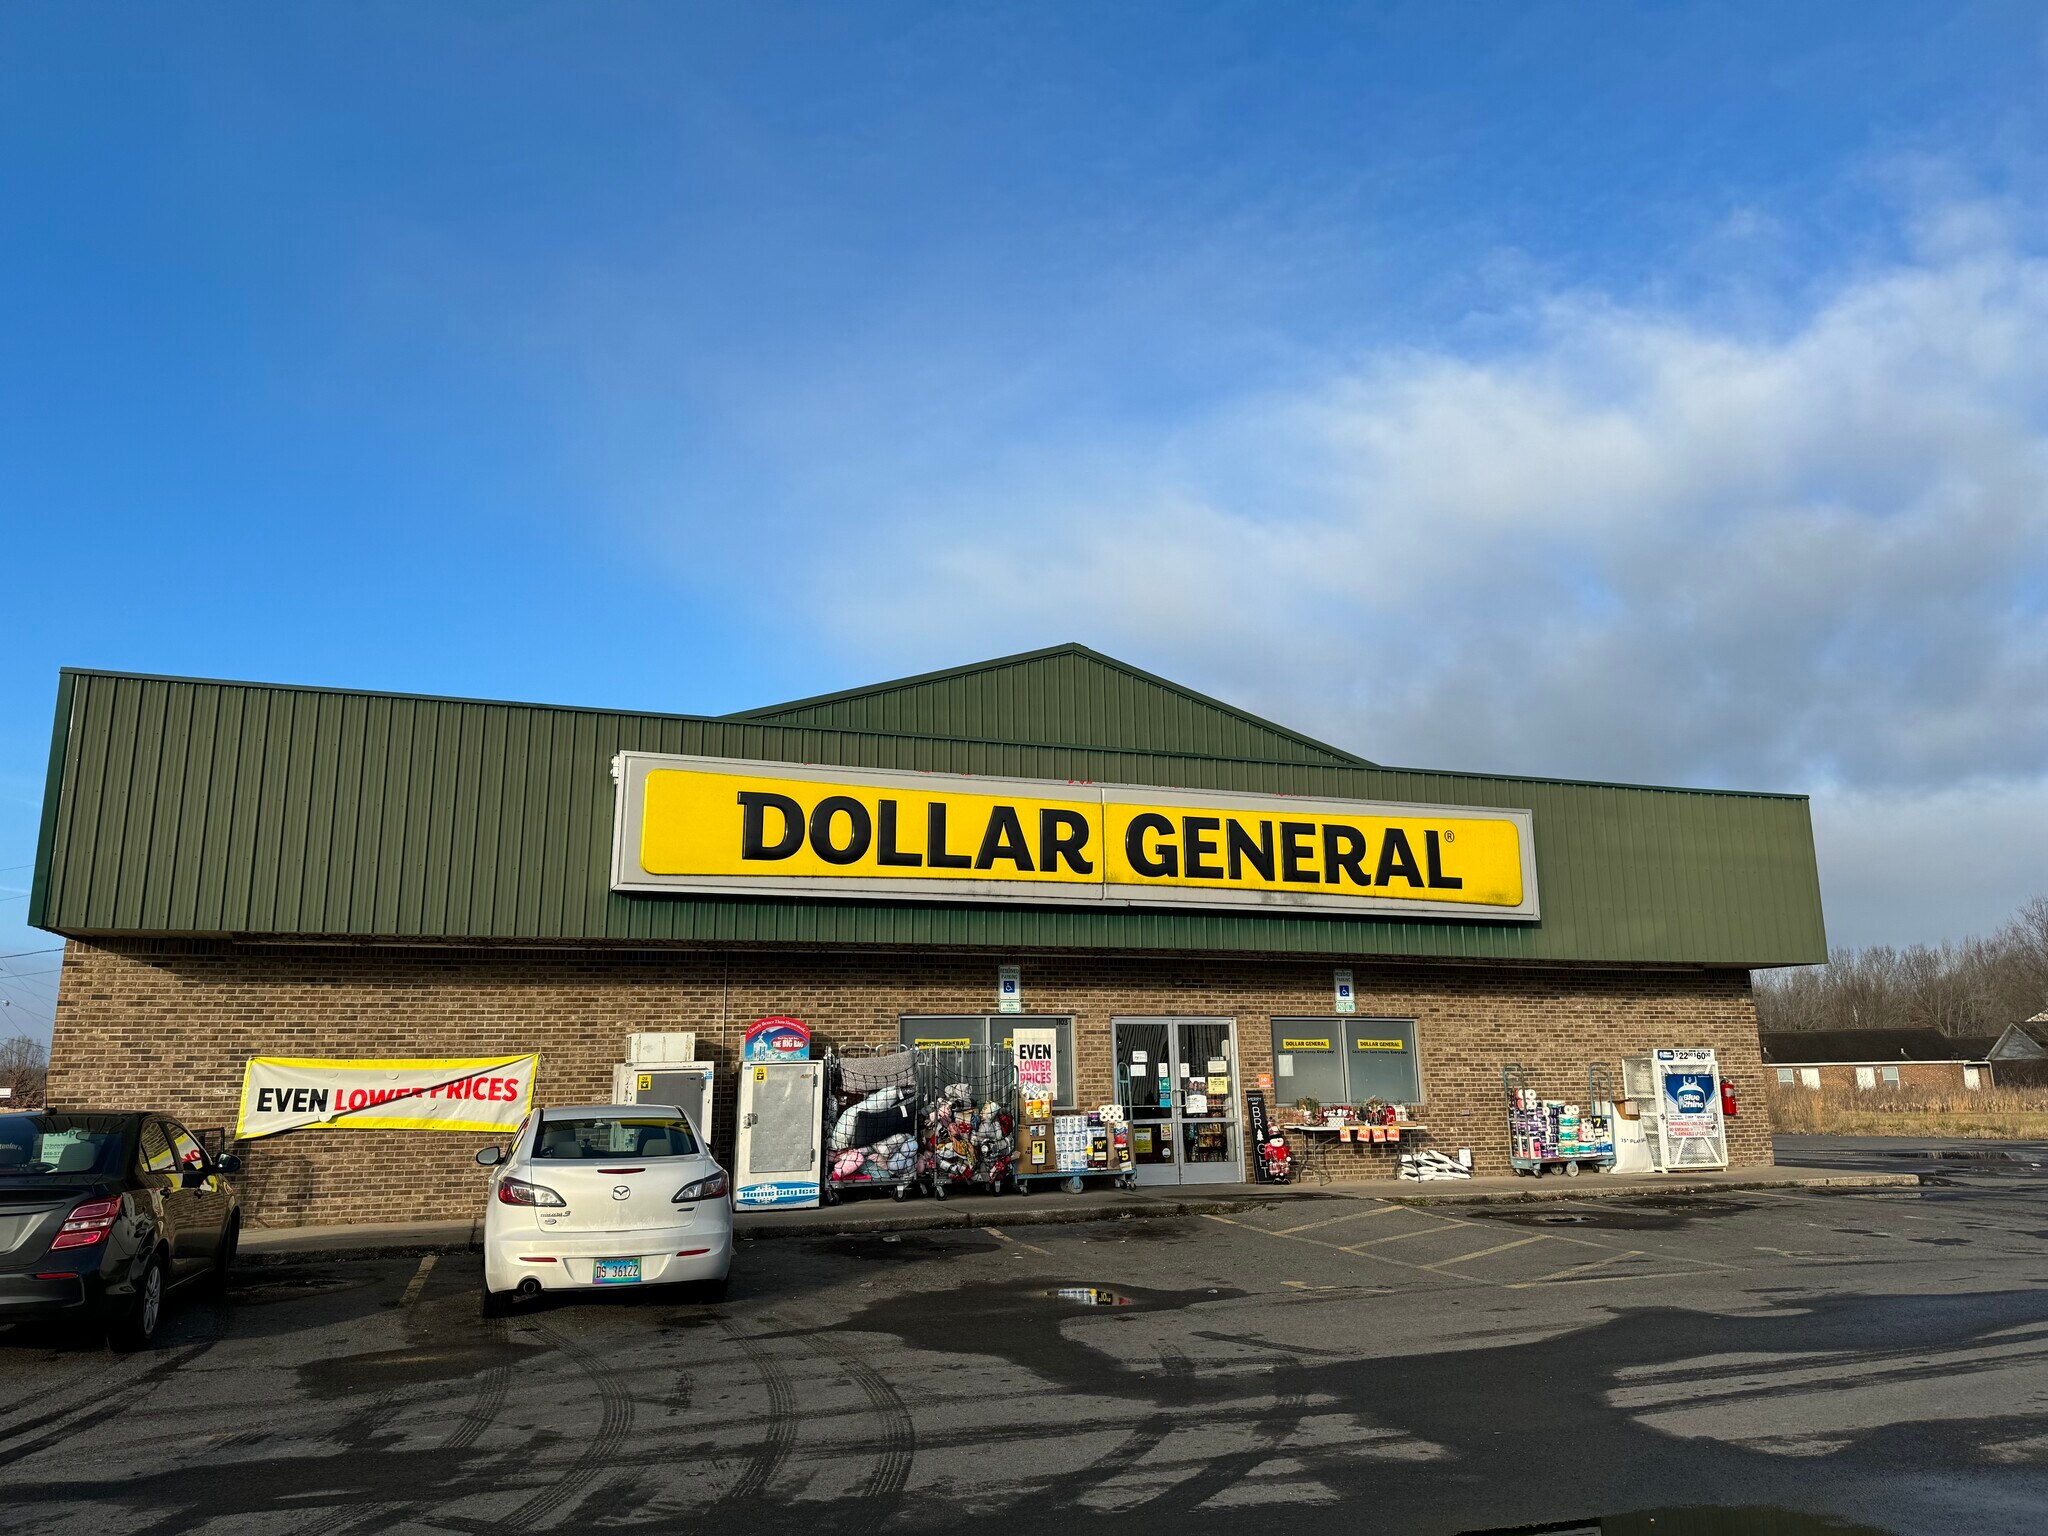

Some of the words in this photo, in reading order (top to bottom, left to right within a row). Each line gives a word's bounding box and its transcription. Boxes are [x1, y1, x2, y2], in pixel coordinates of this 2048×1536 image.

[737, 791, 1094, 875] DOLLAR
[1125, 812, 1463, 890] GENERAL
[1019, 1044, 1051, 1060] EVEN
[1020, 1060, 1052, 1072] LOWER
[1020, 1072, 1052, 1084] PRICES
[256, 1088, 329, 1112] EVEN
[430, 1077, 519, 1101] PRICES
[1034, 1143, 1042, 1153] $1
[1118, 1150, 1128, 1161] $5
[596, 1266, 606, 1278] DS
[612, 1265, 638, 1278] 36122
